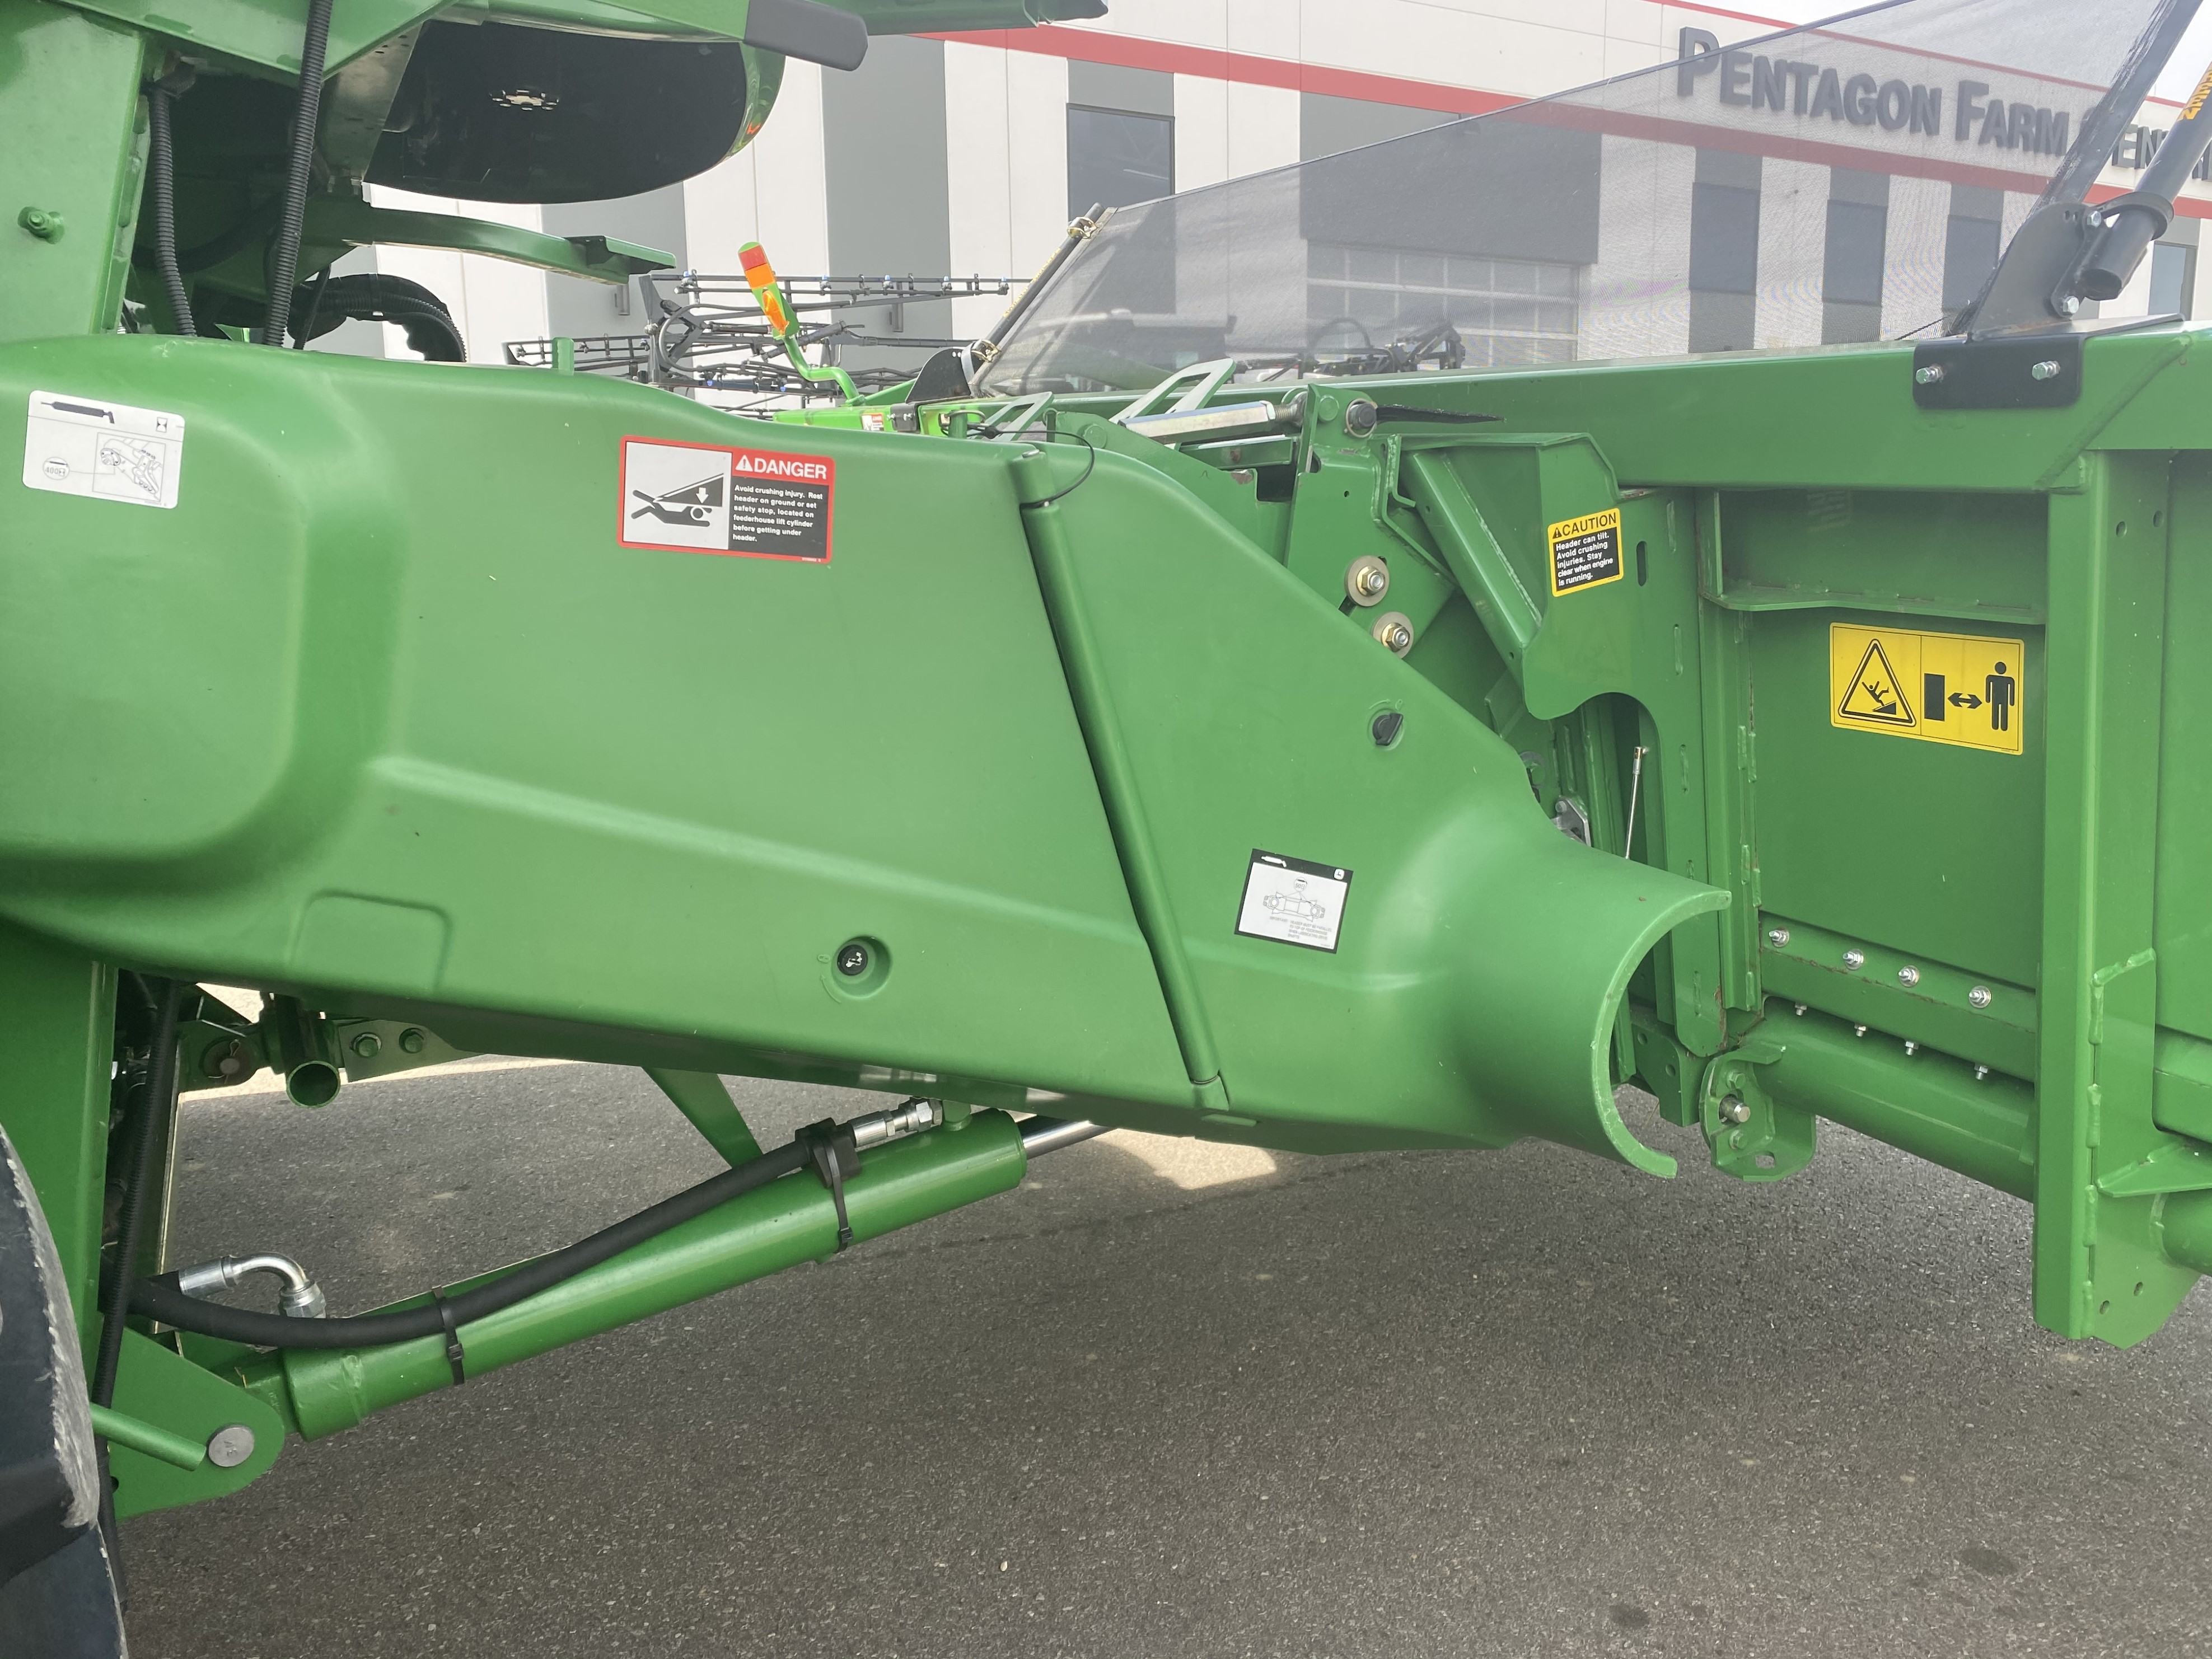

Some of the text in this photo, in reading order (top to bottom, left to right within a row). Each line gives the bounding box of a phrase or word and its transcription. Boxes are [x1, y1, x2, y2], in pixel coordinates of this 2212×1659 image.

[1677, 26, 1942, 136] PENTAGON
[1956, 79, 2070, 157] FARM
[754, 458, 827, 480] DANGER
[734, 484, 754, 493] Avoid
[755, 487, 784, 497] crushing
[785, 489, 805, 499] injury.
[734, 495, 758, 503] header
[733, 505, 756, 513] safety
[777, 508, 803, 517] located
[733, 514, 775, 524] feederhouse
[733, 524, 755, 532] before
[756, 527, 780, 535] getting
[1562, 512, 1616, 536] CAUTION
[732, 533, 757, 542] header.
[1556, 531, 1610, 551] Header can tilt.
[1556, 541, 1608, 560] Avoid crushing
[1557, 551, 1602, 570] injuries. Stay
[1558, 557, 1614, 578] clear when engine
[1566, 571, 1593, 585] running.
